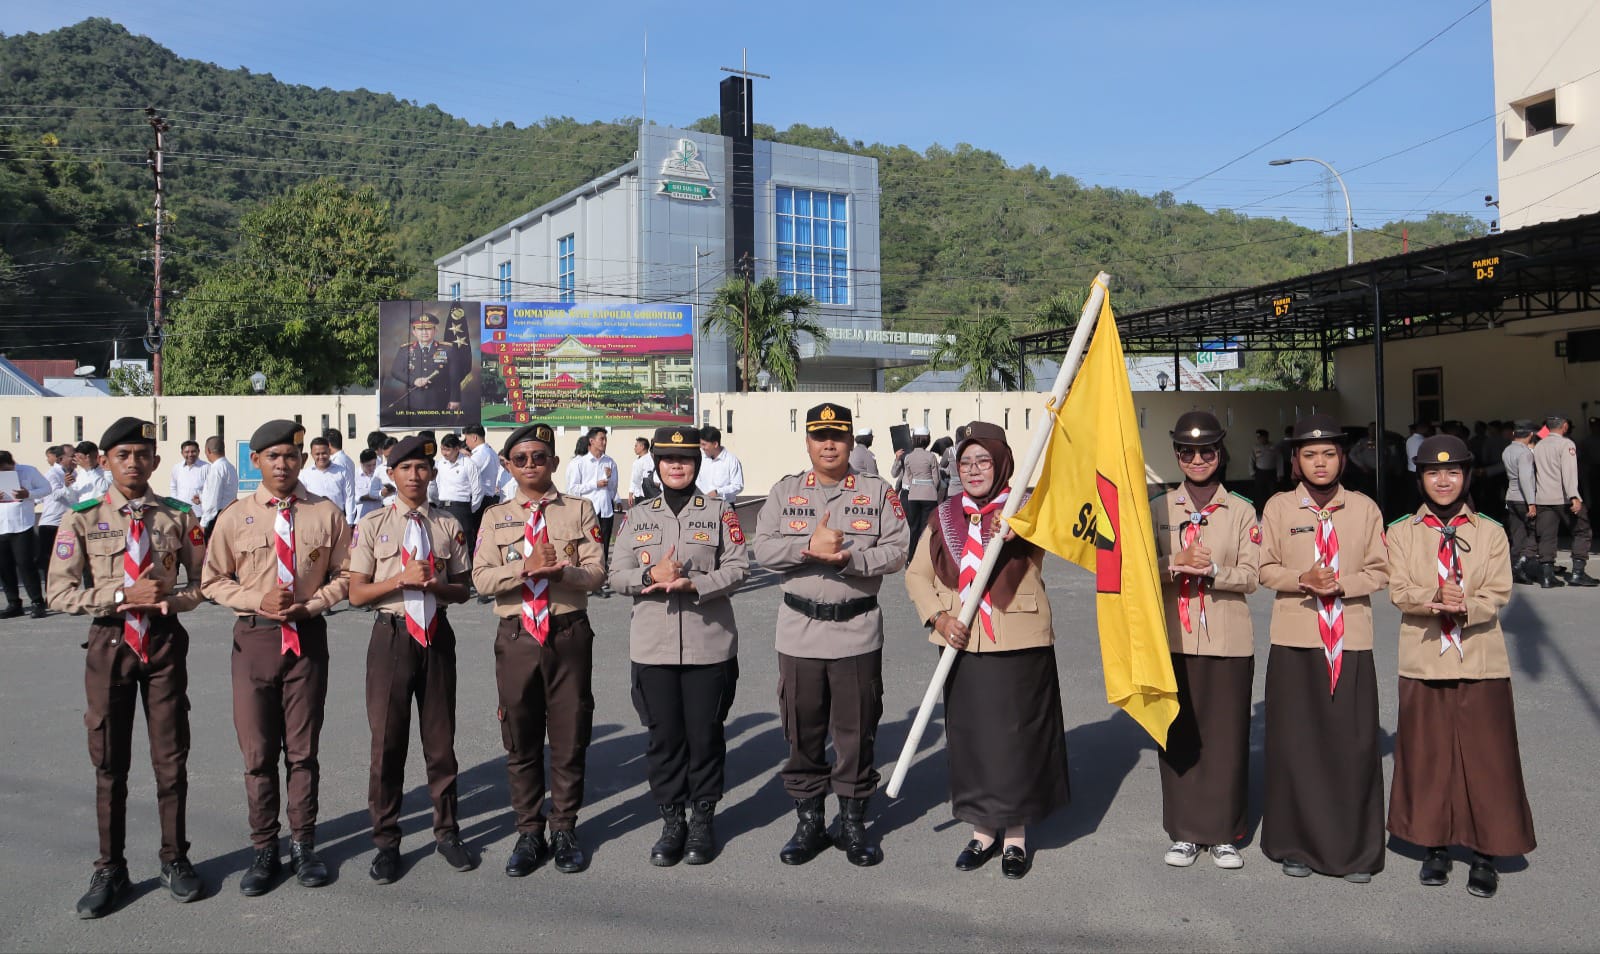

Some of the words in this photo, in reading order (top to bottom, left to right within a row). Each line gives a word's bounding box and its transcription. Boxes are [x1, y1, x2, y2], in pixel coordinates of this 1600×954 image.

[1472, 256, 1499, 268] PARKIR
[1476, 266, 1494, 280] D-5
[514, 308, 565, 318] COMMANDER
[634, 310, 683, 320] GORONTALO
[1276, 304, 1288, 316] D-7
[498, 332, 502, 340] 1
[865, 330, 908, 344] KRISTEN
[500, 344, 506, 352] 2
[504, 355, 509, 364] 3
[507, 367, 512, 375] 4
[510, 378, 516, 386] 5
[516, 402, 522, 410] 7
[520, 414, 526, 422] 8
[782, 507, 816, 516] ANDIK
[844, 506, 878, 516] POLRI
[634, 523, 660, 532] JULIA
[688, 521, 717, 529] POLRI
[1072, 502, 1097, 546] SA
